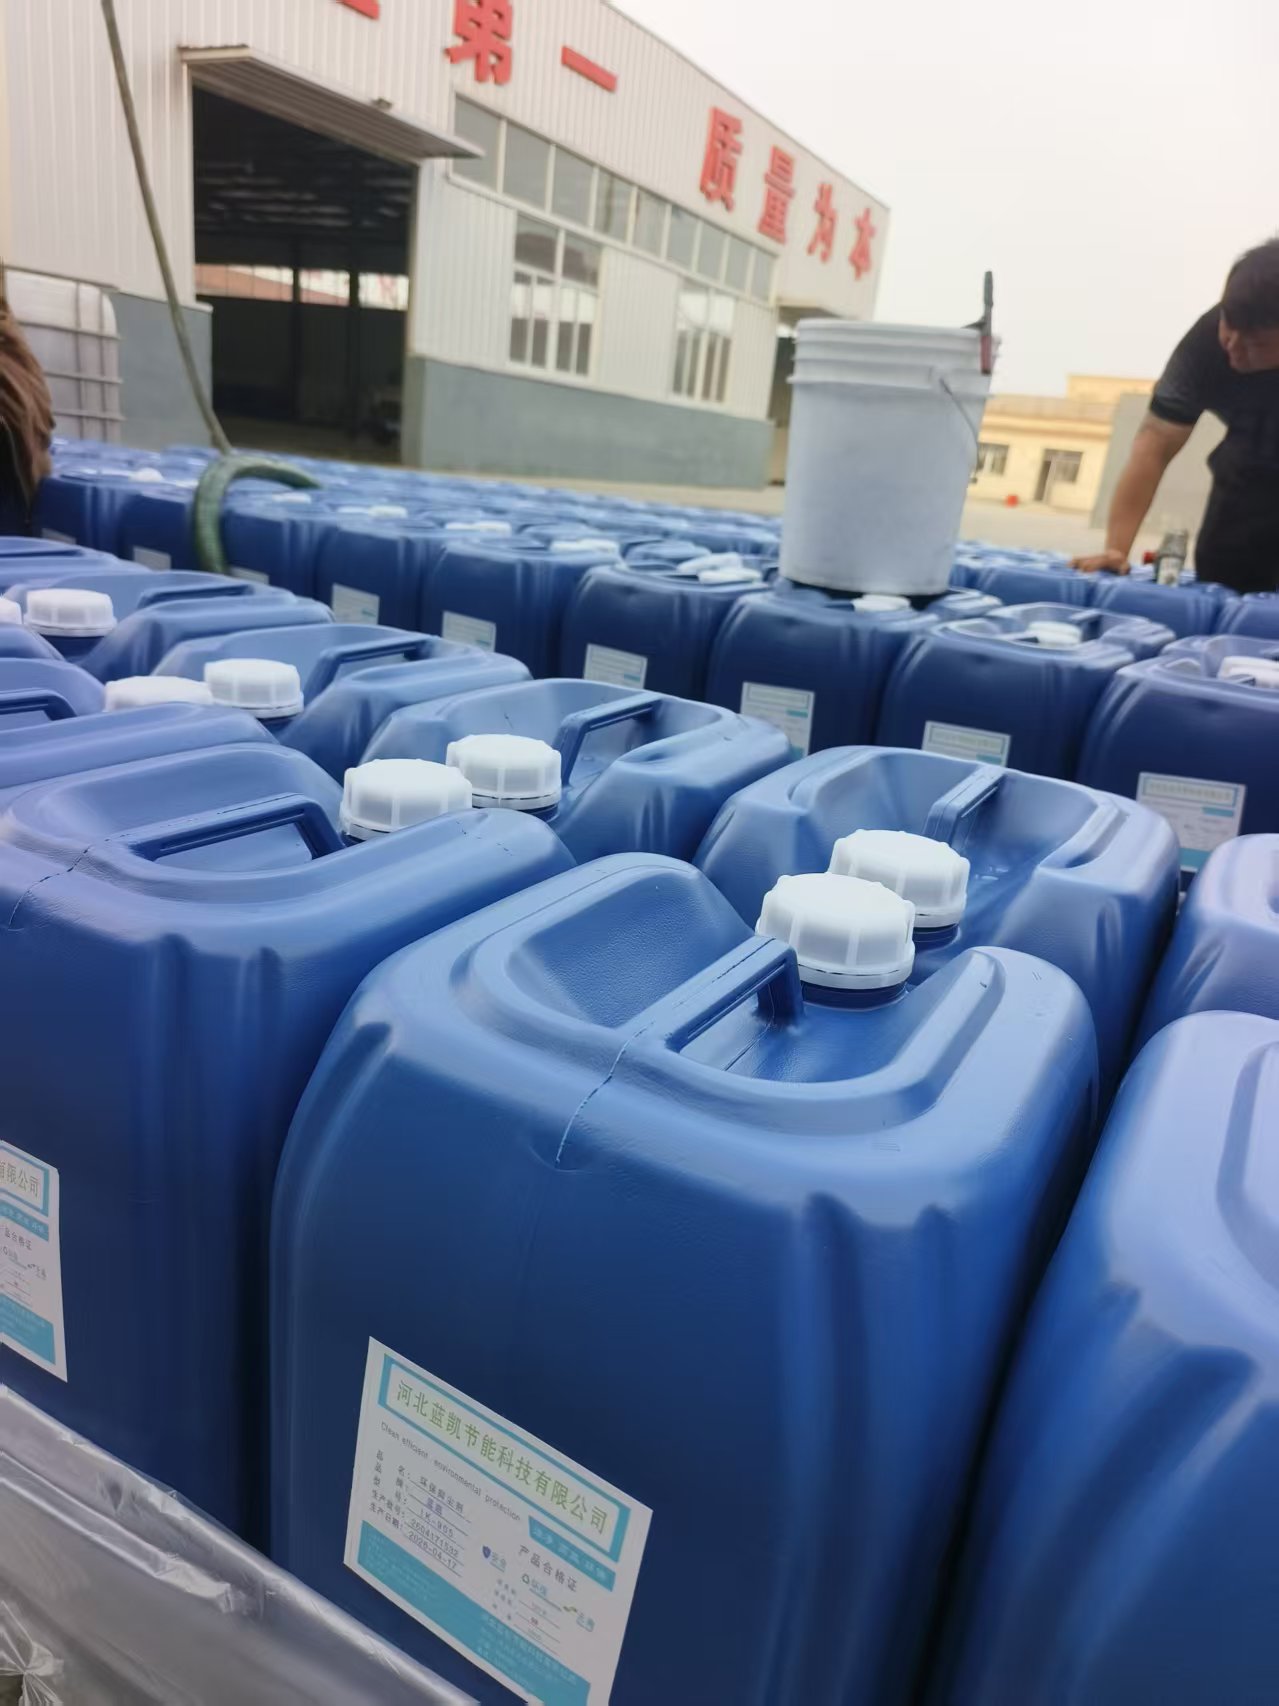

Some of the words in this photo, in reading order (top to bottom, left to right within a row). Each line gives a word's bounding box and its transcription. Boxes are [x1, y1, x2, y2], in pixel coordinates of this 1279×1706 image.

[699, 106, 877, 281] 质量为本
[381, 1421, 400, 1440] Clean
[401, 1438, 429, 1458] efficient
[433, 1460, 481, 1497] environmental
[485, 1494, 521, 1521] protection
[396, 1379, 608, 1535] 河北蓝凯节能科技有限公司
[518, 1544, 577, 1592] 产品合格证
